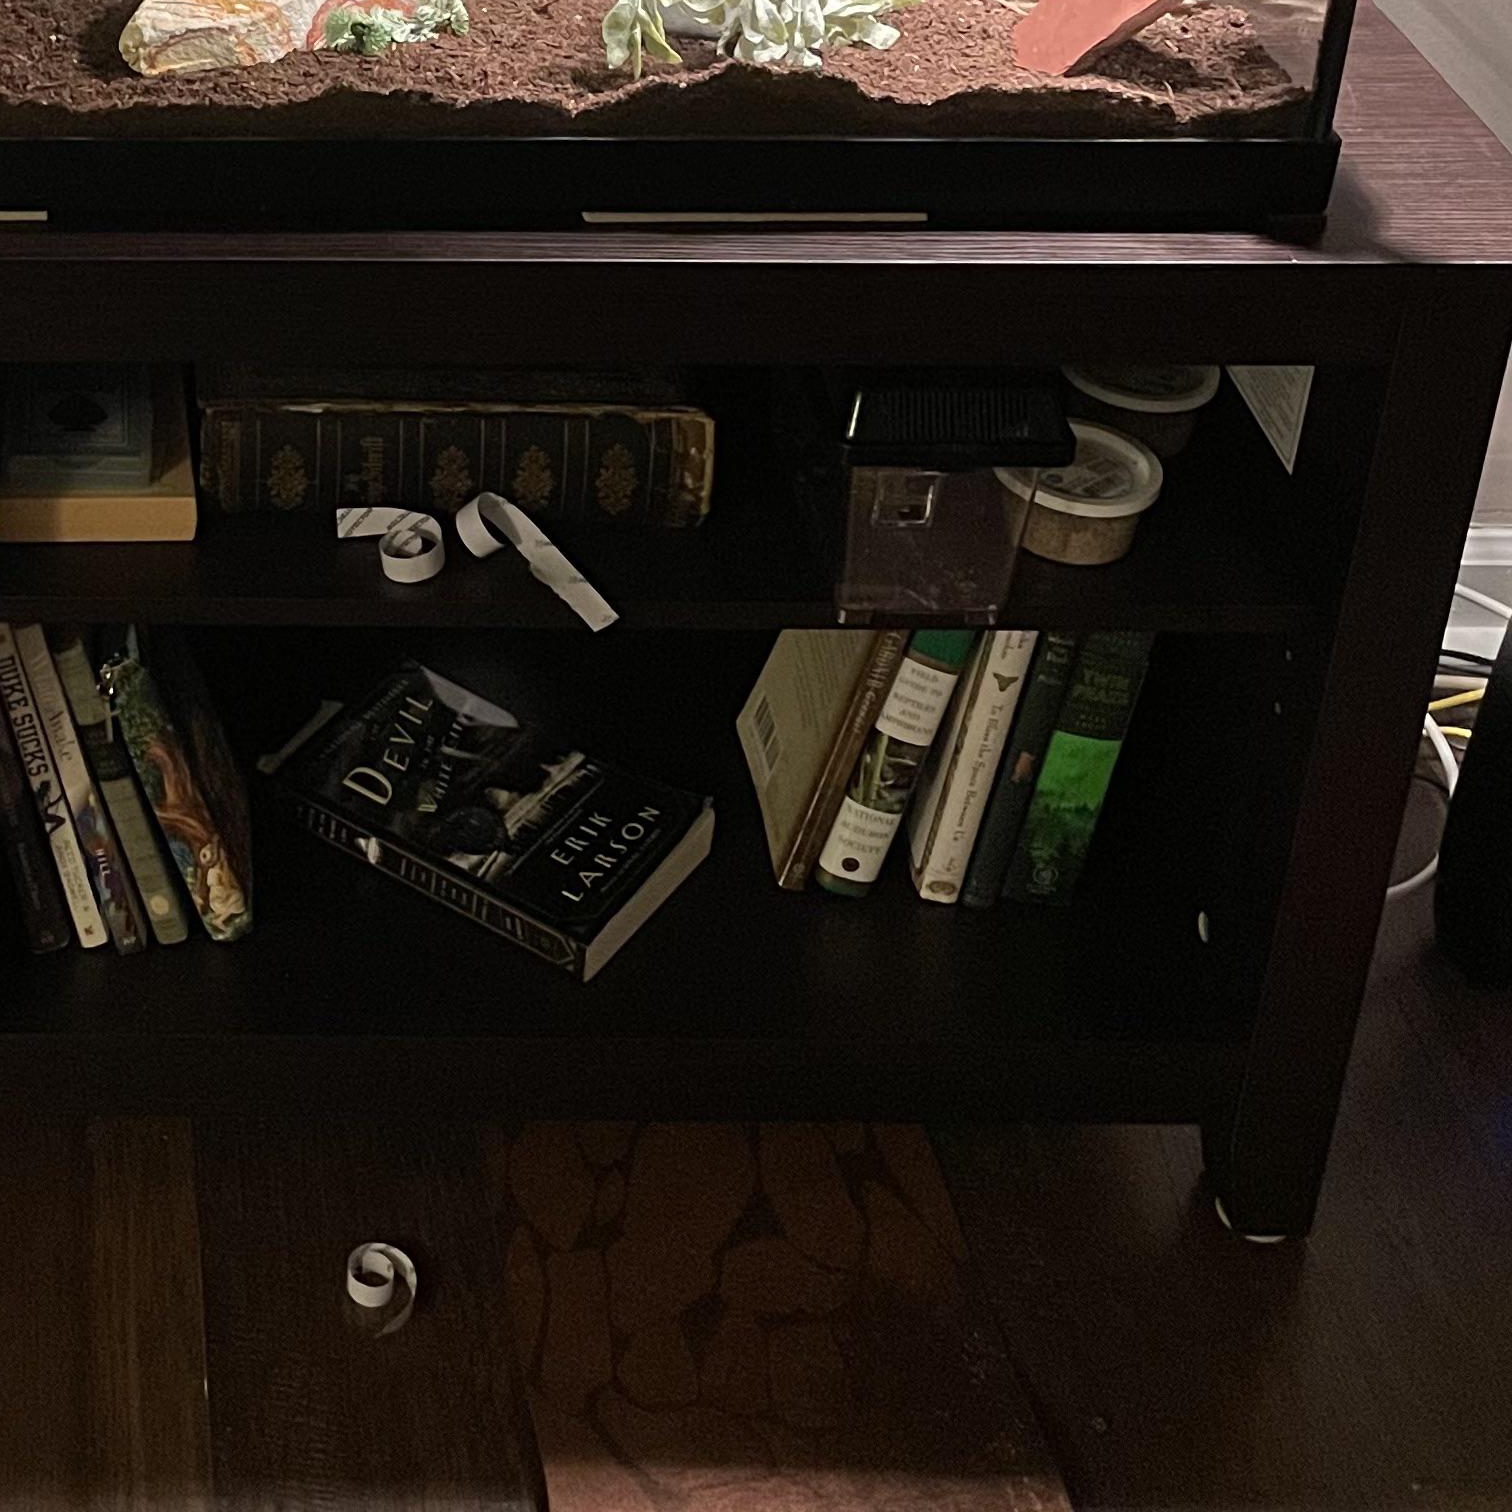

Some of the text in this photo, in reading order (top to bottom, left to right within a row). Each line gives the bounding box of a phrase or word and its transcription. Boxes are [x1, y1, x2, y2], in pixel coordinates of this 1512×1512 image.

[12, 713, 49, 778] SUCKS
[342, 696, 434, 806] DEVIL
[95, 848, 112, 877] HILL
[550, 810, 613, 866] ERIK
[561, 805, 661, 903] LARSON
